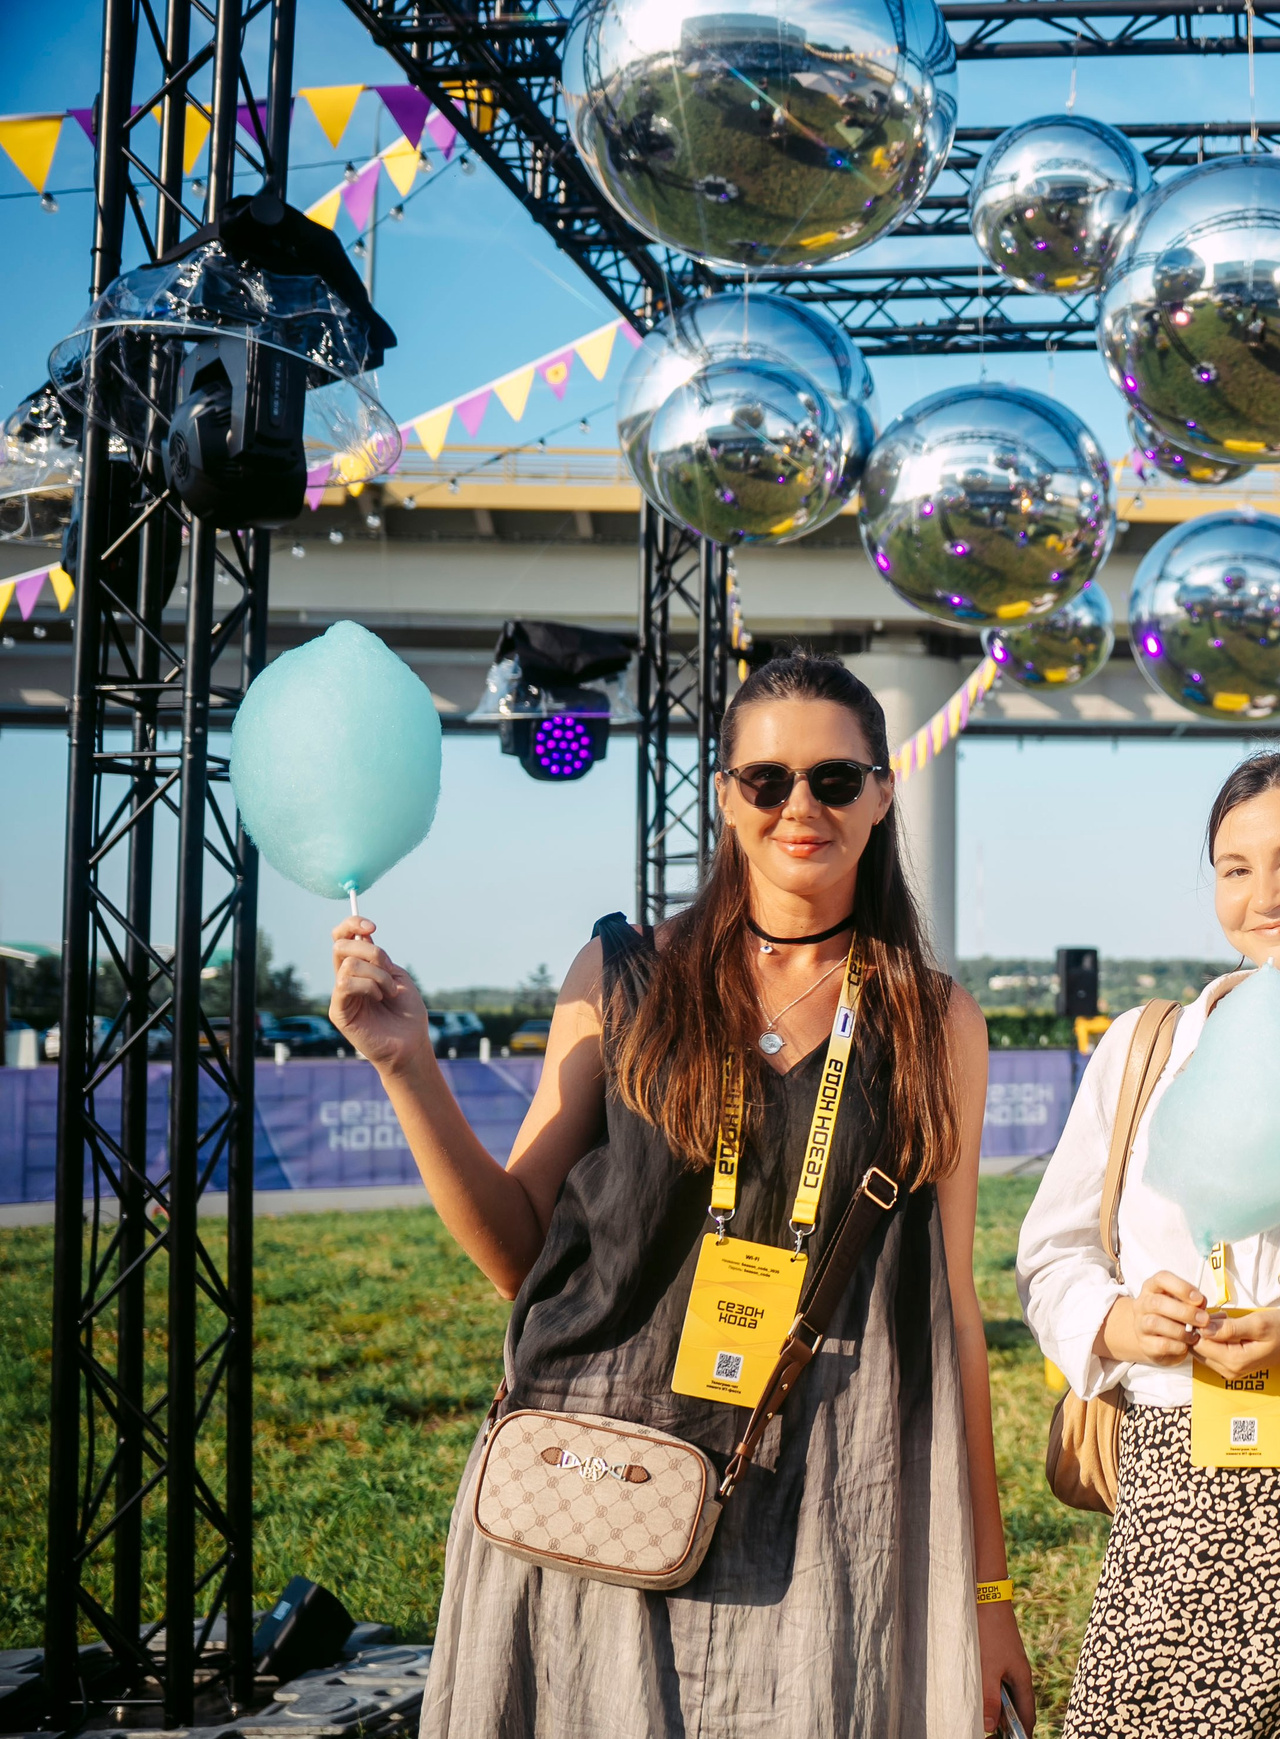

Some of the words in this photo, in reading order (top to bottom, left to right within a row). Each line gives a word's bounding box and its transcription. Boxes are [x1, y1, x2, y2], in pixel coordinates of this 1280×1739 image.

[804, 1116, 832, 1189] сезон
[819, 1058, 844, 1112] кода
[717, 1300, 765, 1319] сезон
[718, 1312, 758, 1329] кода
[1225, 1380, 1265, 1391] кода
